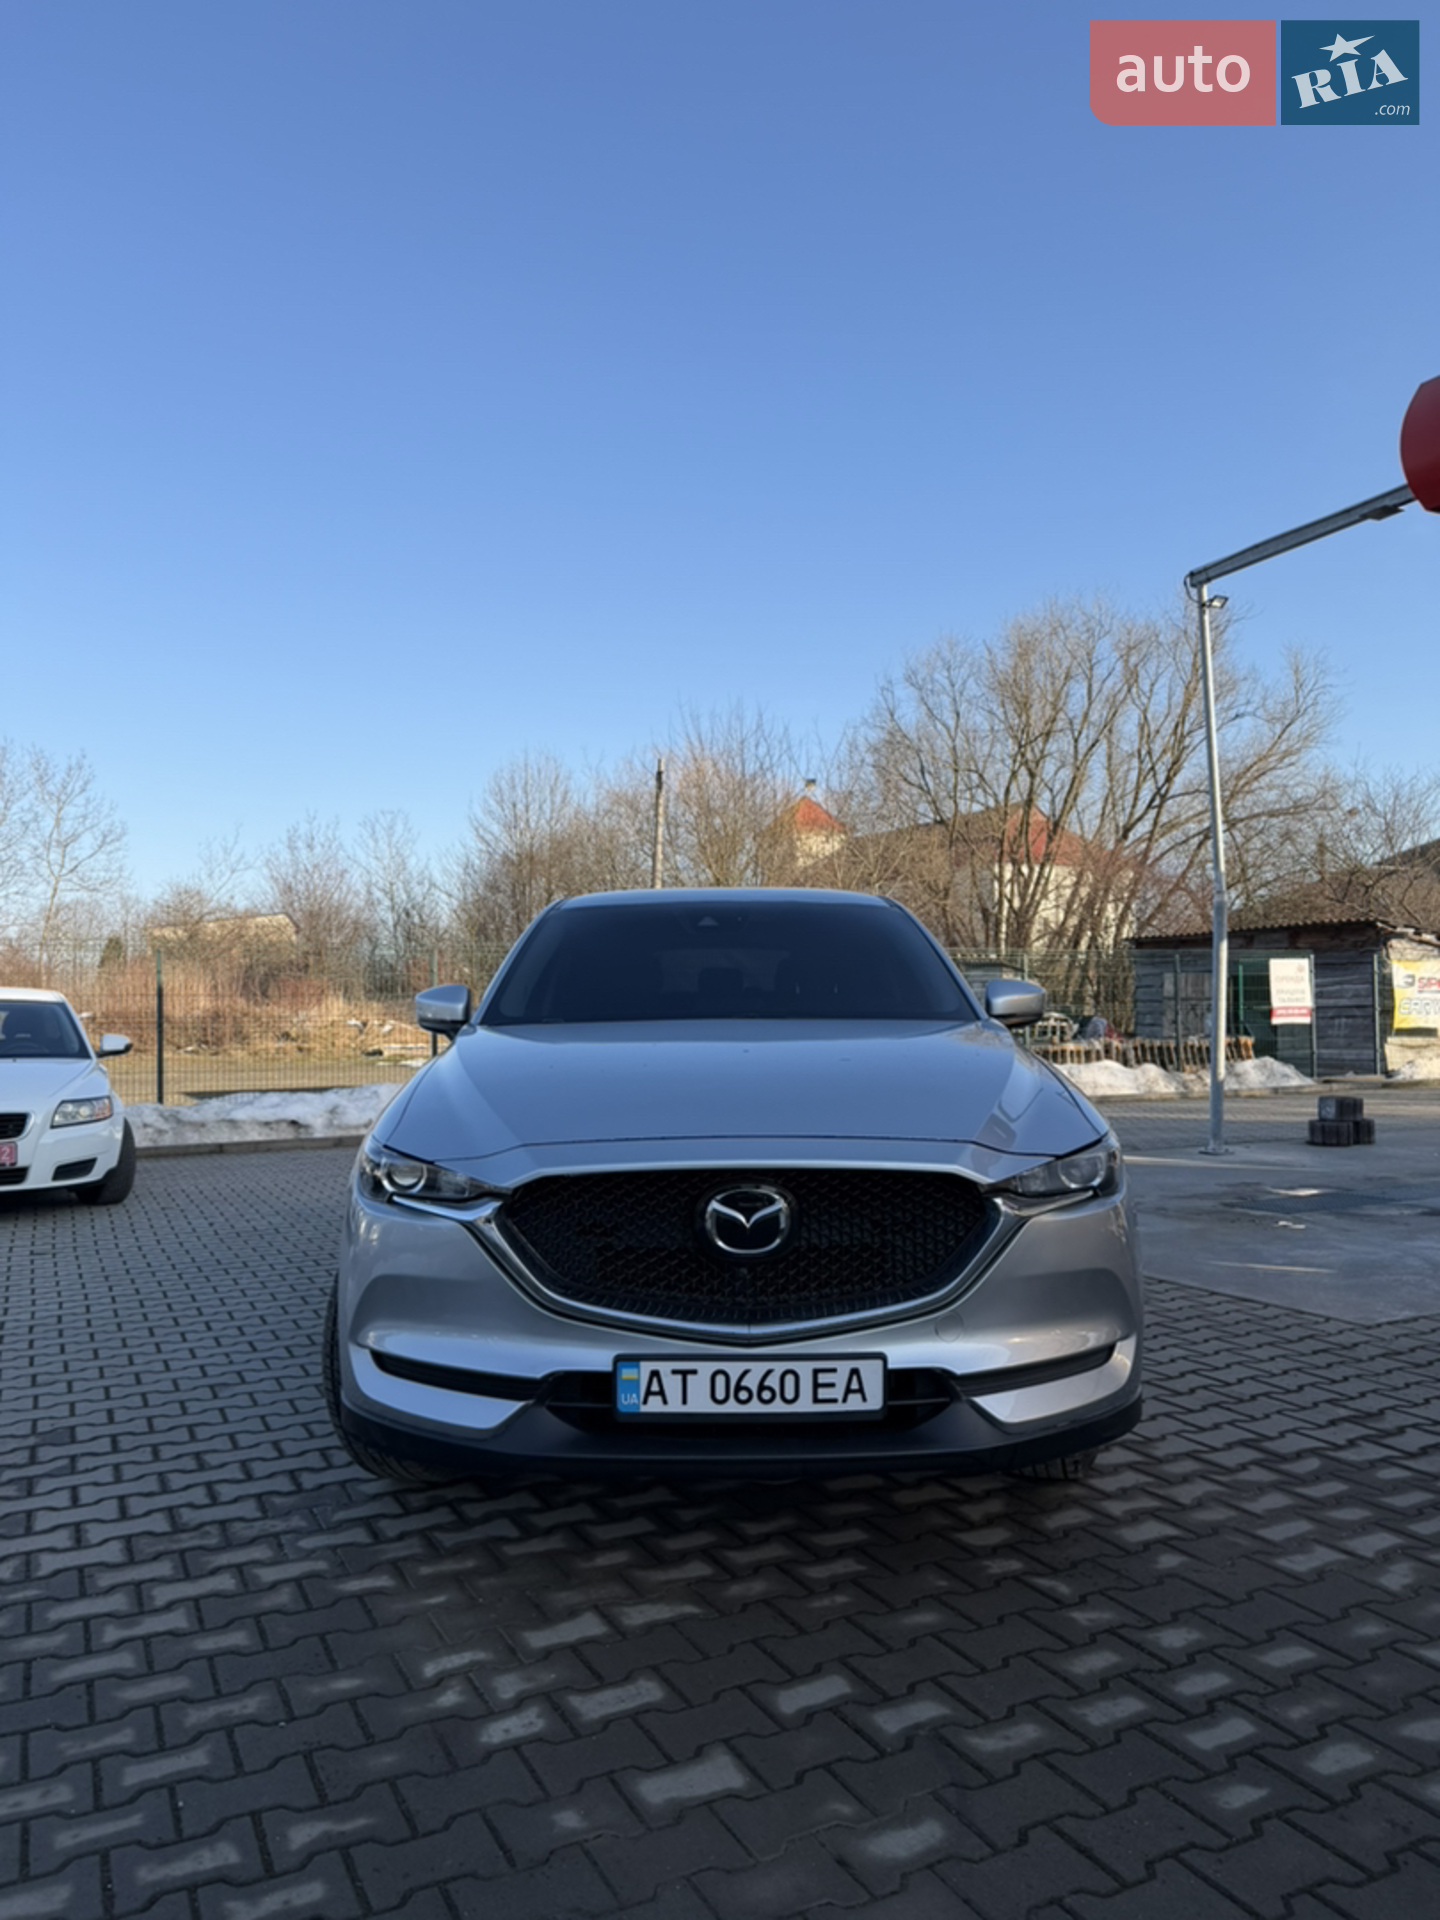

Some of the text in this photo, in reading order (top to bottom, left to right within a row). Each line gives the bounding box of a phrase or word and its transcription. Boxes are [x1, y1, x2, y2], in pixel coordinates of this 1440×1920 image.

[642, 1367, 868, 1405] AT 0660 EA
[621, 1393, 639, 1405] UA
